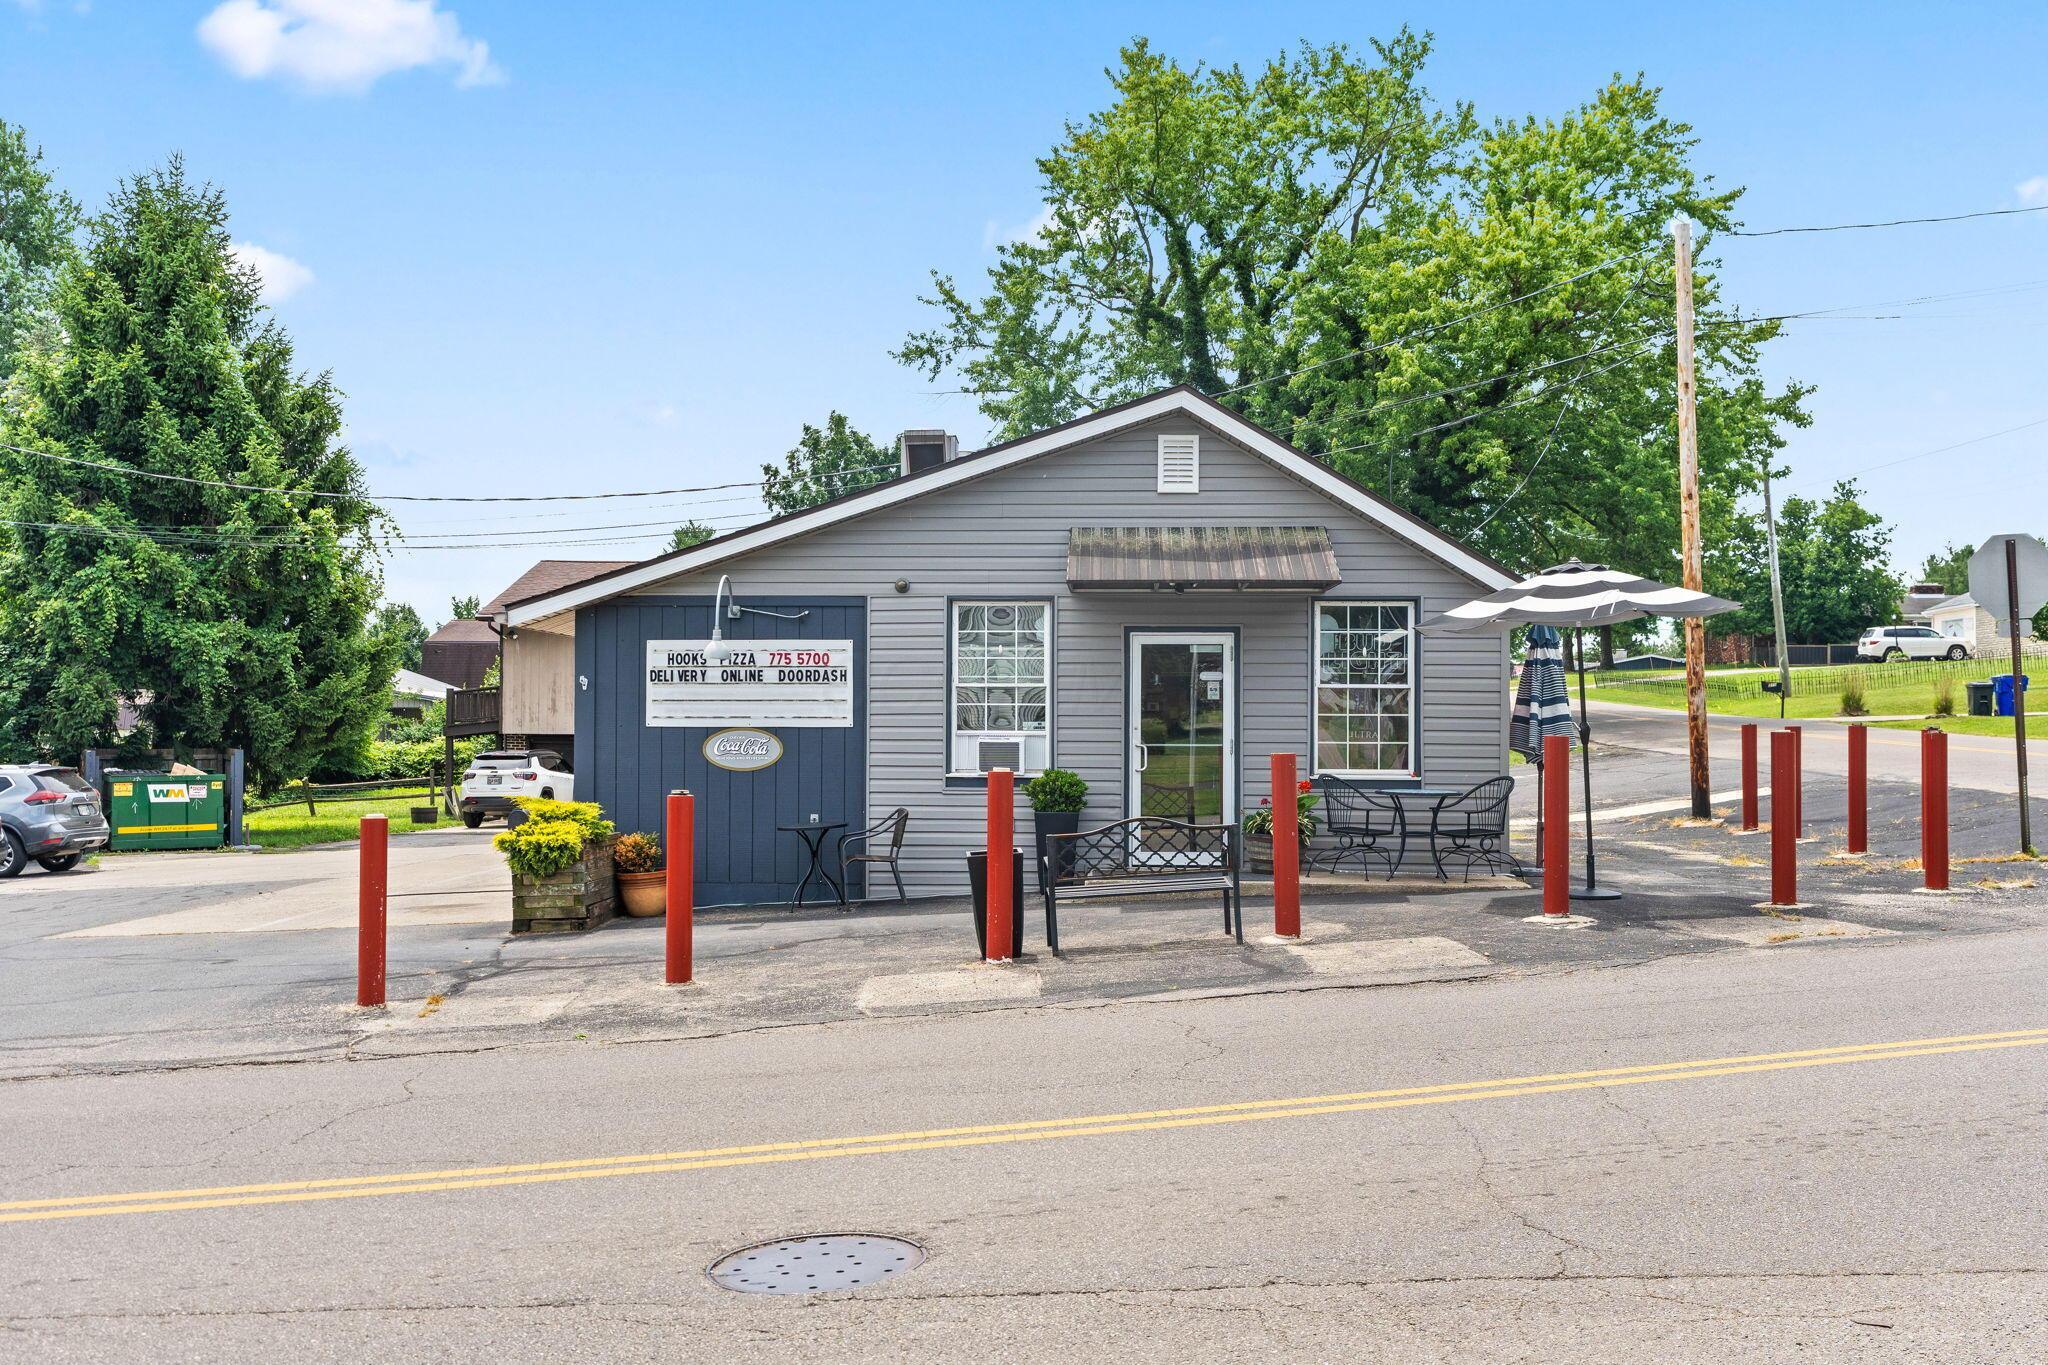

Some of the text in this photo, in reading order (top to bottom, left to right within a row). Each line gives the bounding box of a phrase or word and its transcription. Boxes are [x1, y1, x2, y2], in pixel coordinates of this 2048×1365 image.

[667, 652, 707, 665] HOOKS
[769, 652, 792, 665] 775
[721, 669, 764, 682] ONLINE
[778, 669, 847, 682] DOORDASH
[713, 736, 771, 756] Coca-Cola
[152, 788, 185, 798] WM
